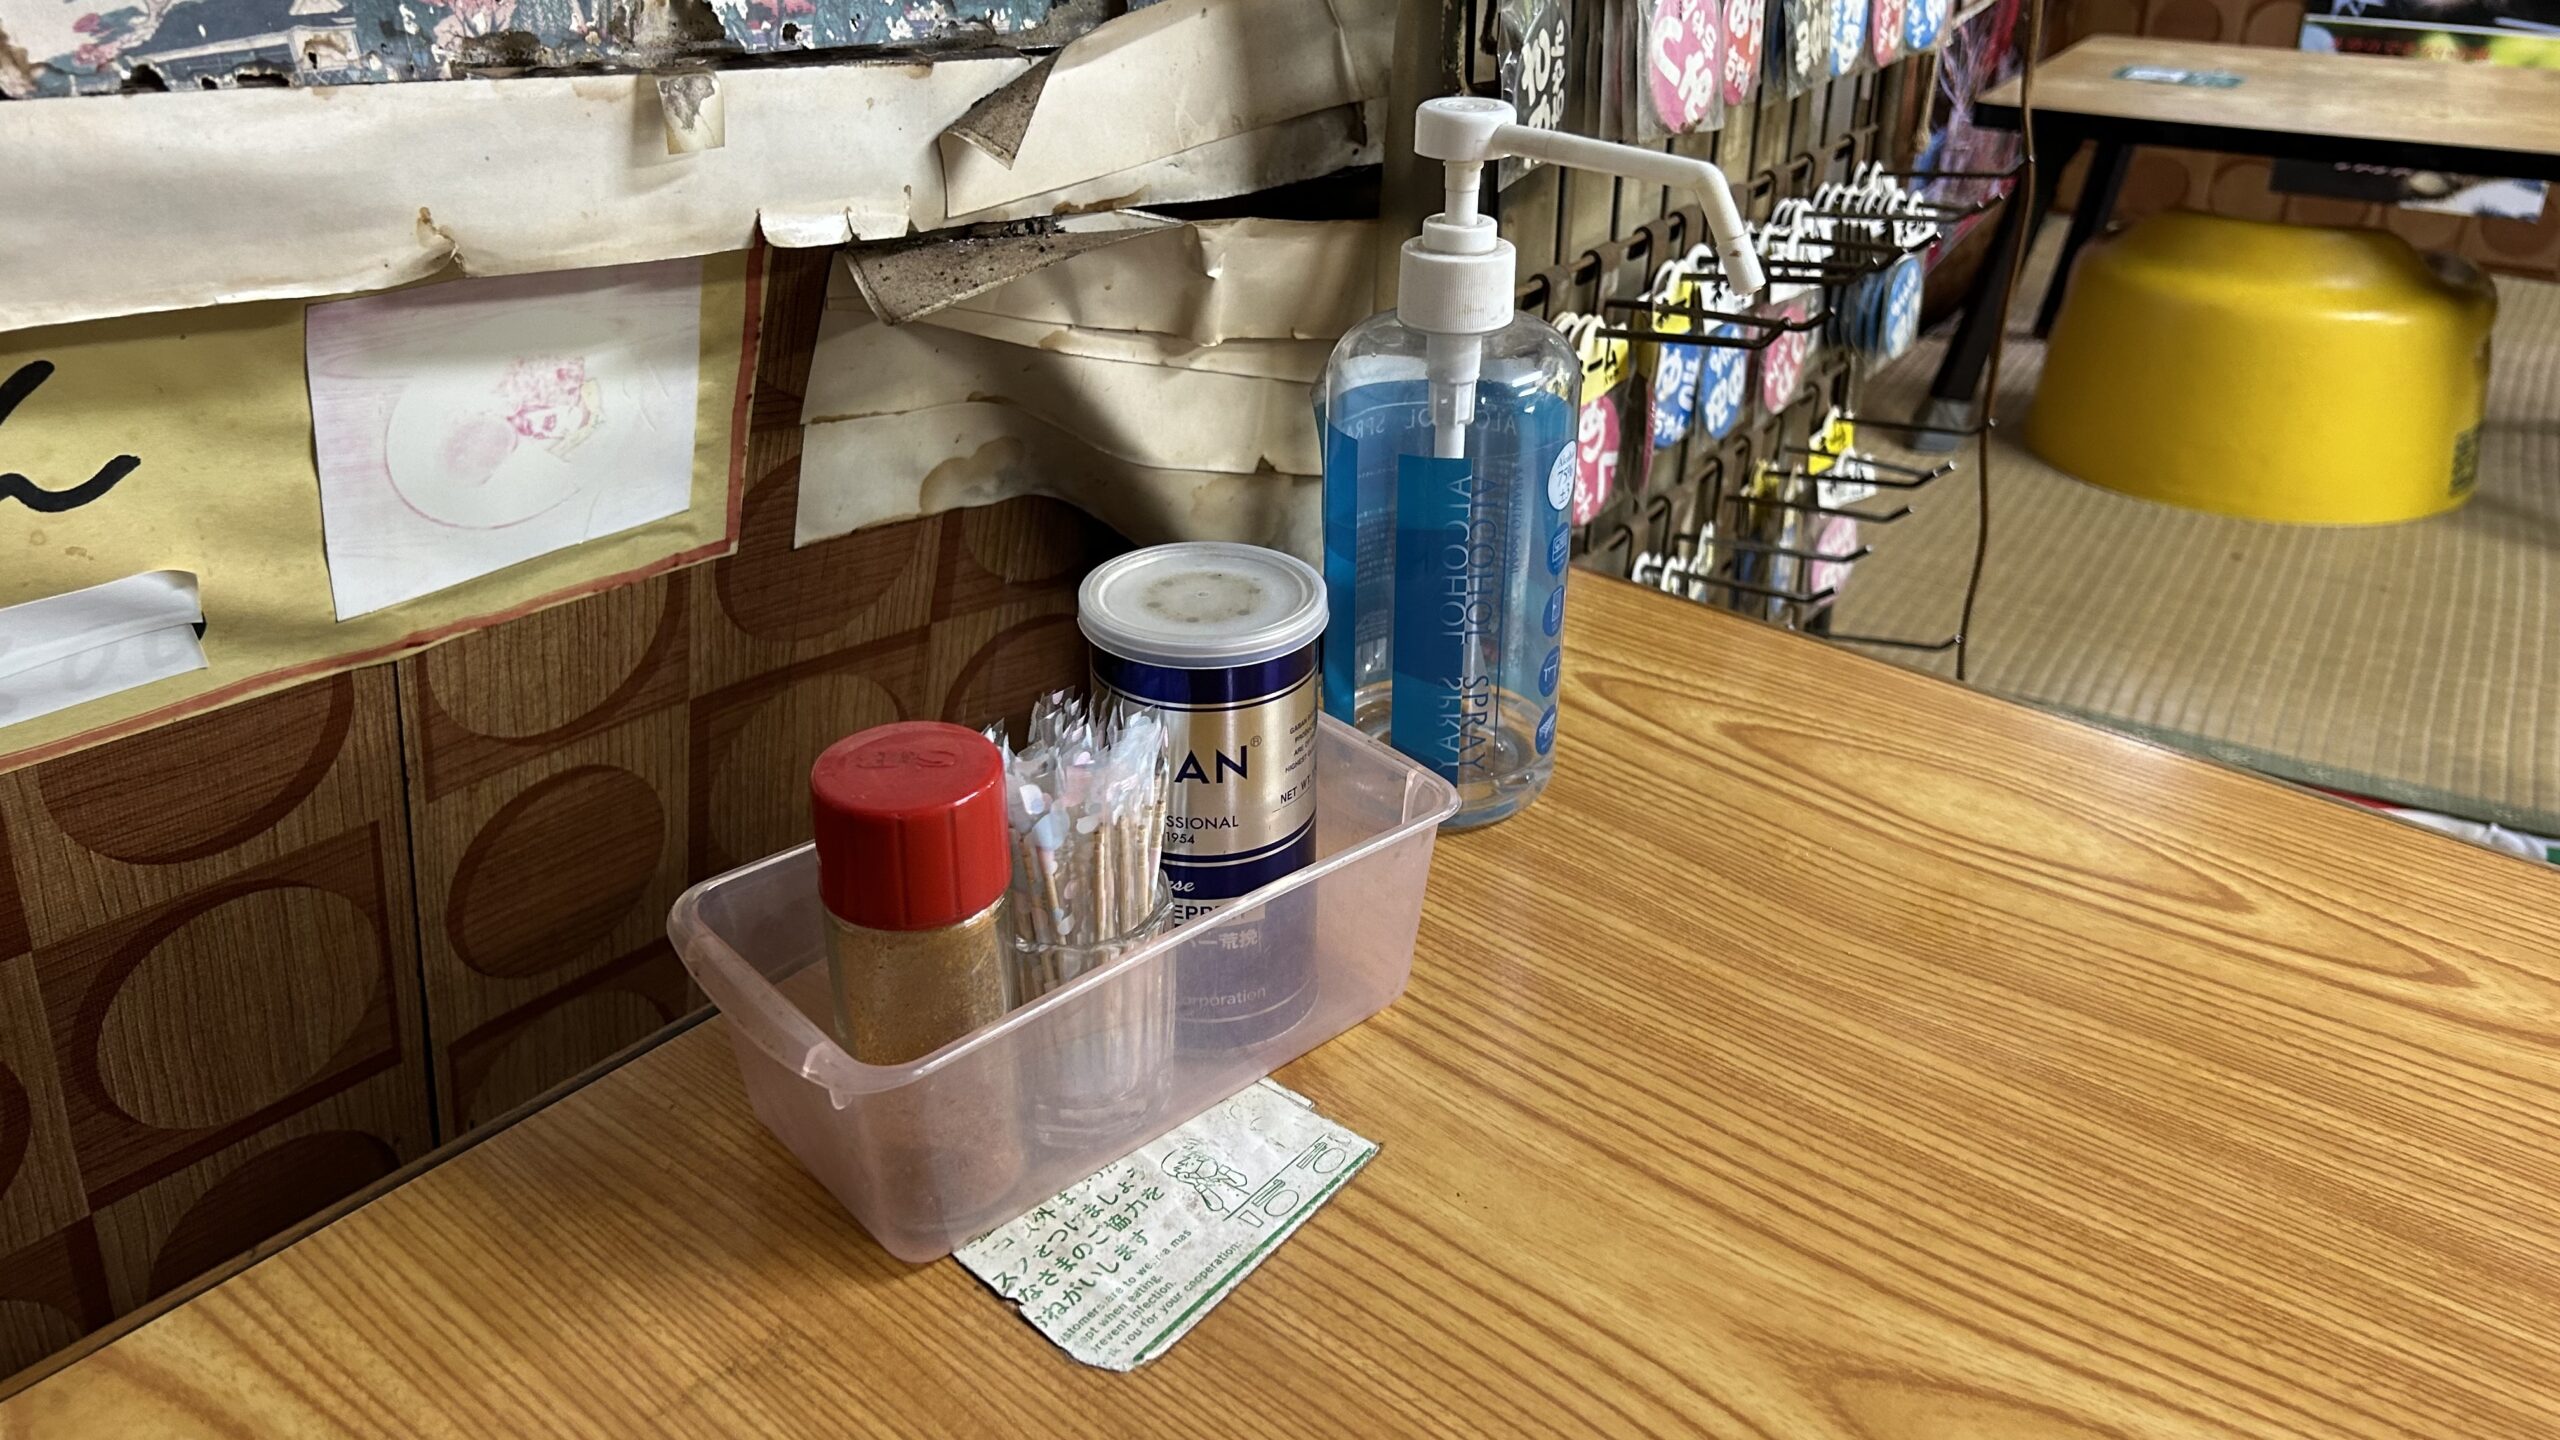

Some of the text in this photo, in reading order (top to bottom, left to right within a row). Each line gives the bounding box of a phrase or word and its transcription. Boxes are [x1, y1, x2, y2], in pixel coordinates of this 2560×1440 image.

[1652, 15, 1713, 121] みつ
[1459, 474, 1499, 771] ALCOHOL SPRAY
[1280, 786, 1298, 804] NET
[1166, 831, 1195, 845] 1954
[1018, 1186, 1165, 1303] なさまのご協力を
[1123, 1276, 1137, 1288] to
[1099, 1303, 1128, 1328] when
[1121, 1328, 1142, 1347] you
[1160, 1290, 1184, 1315] your
